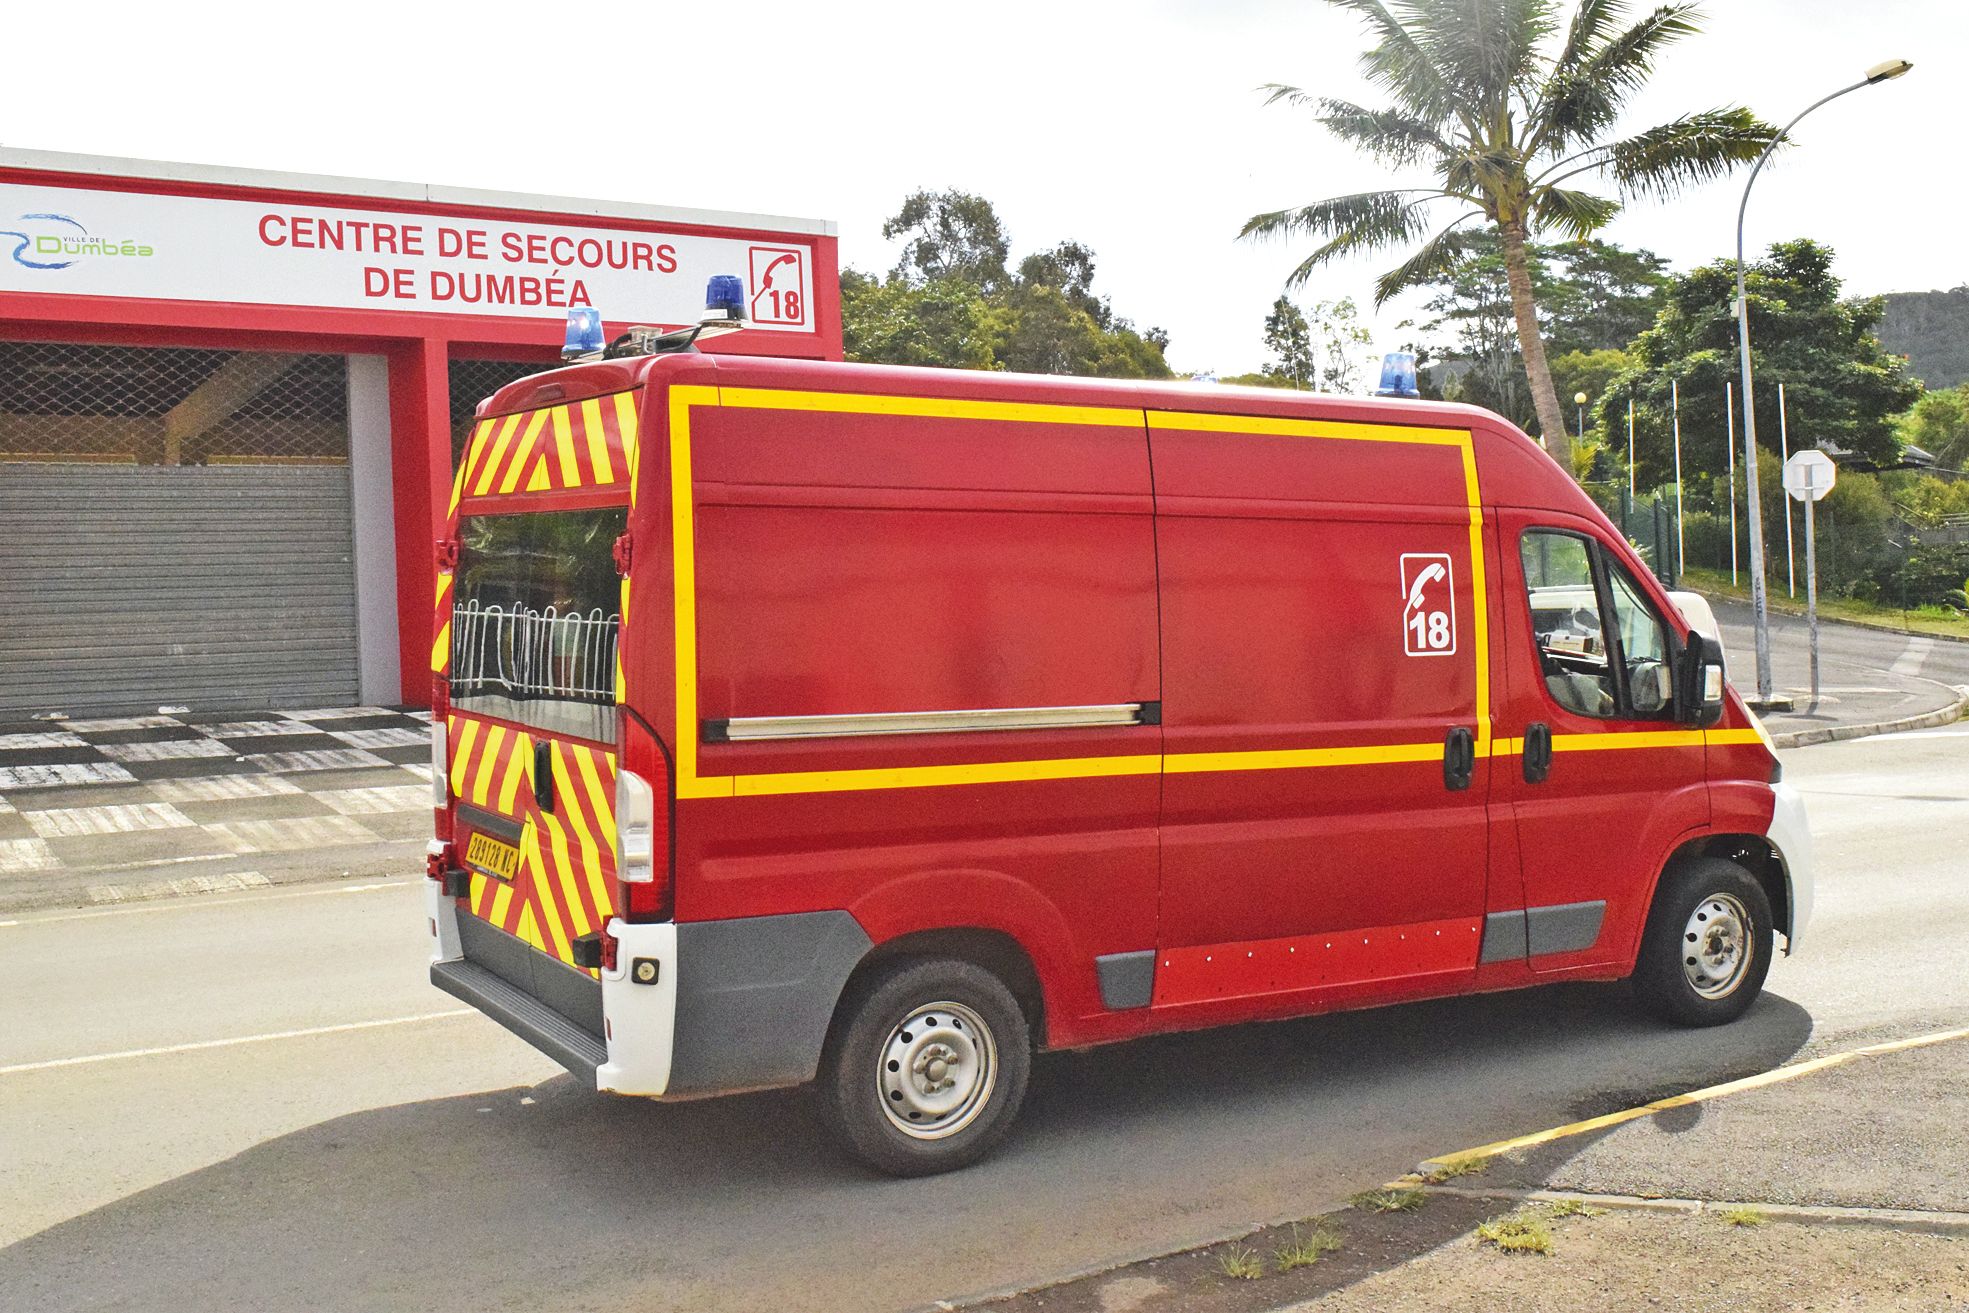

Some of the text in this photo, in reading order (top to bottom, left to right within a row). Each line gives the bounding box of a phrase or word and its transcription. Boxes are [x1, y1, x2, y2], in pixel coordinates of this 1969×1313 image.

[36, 236, 154, 256] Dumbéa
[259, 214, 678, 274] CENTRE DE SECOURS
[364, 267, 592, 308] DE DUMBÉA
[769, 290, 800, 320] 18
[1409, 611, 1450, 649] 18
